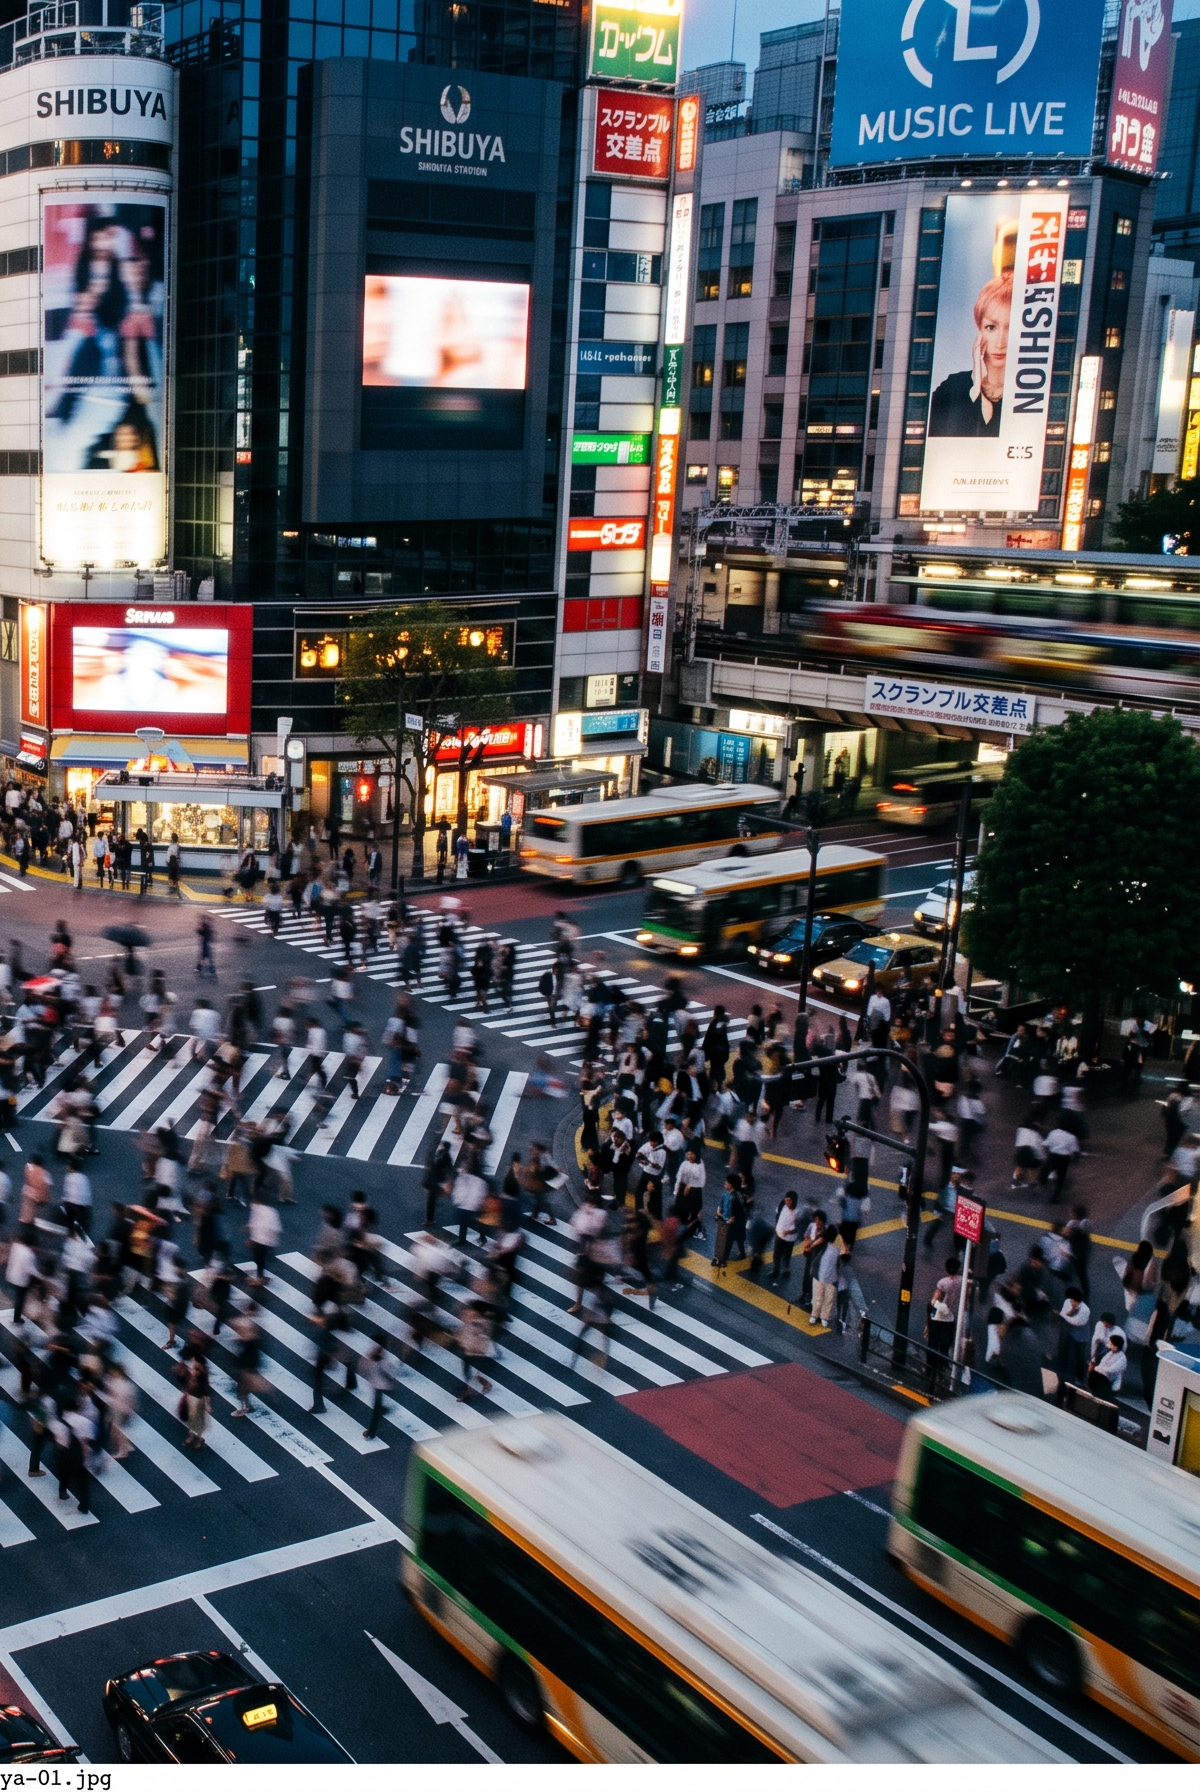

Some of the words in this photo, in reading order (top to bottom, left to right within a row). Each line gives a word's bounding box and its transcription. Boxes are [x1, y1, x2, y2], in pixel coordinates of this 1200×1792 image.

[36, 88, 167, 121] SHIBUYA
[858, 103, 974, 146] MUSIC
[984, 102, 1067, 135] LIVE
[399, 126, 506, 163] SHIBUYA
[605, 132, 663, 163] 交差点
